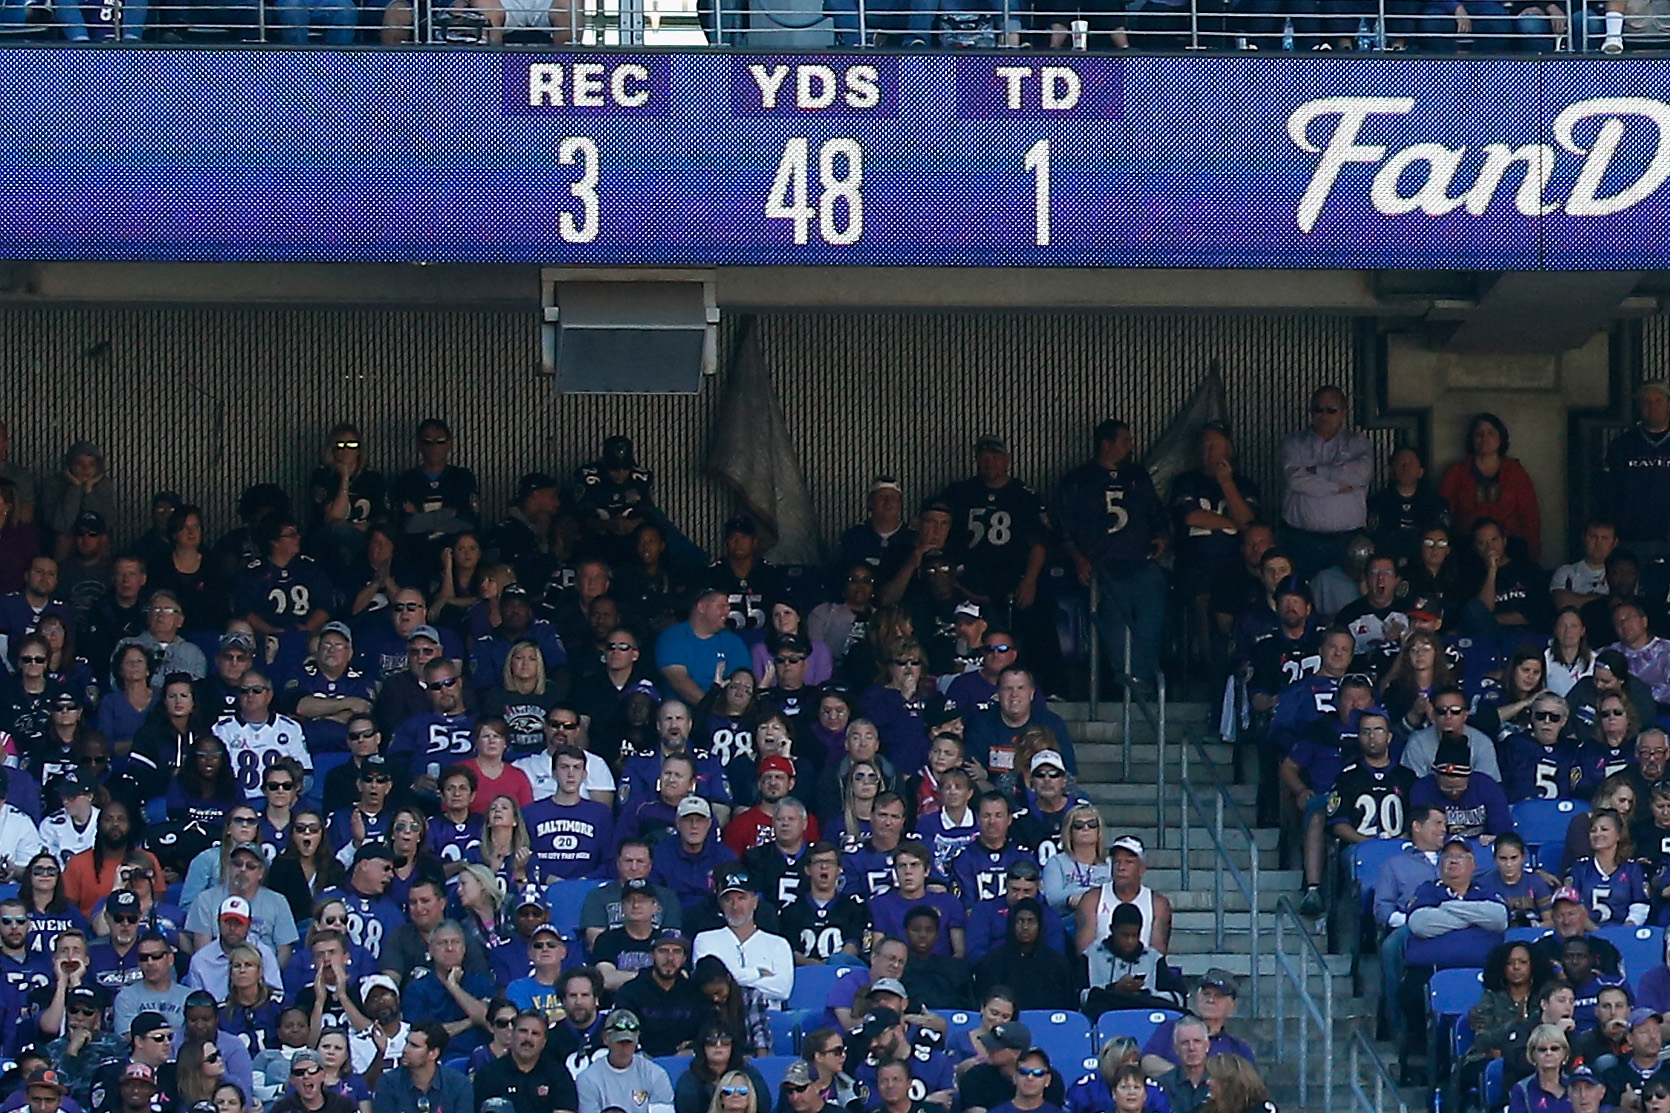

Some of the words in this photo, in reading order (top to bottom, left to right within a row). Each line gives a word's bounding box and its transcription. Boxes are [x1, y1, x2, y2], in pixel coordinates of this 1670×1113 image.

[528, 62, 651, 108] REC
[748, 64, 881, 110] YDS
[996, 66, 1082, 111] TD
[558, 136, 600, 244] 3
[765, 137, 864, 246] 48
[1024, 139, 1050, 246] 1
[967, 509, 1011, 545] 58
[1106, 491, 1128, 534] 5
[727, 593, 765, 630] 55
[427, 724, 471, 753] 55
[712, 729, 753, 767] 88
[1536, 764, 1558, 799] 5
[536, 821, 595, 837] BALTIMORE
[1357, 795, 1404, 836] 20
[557, 838, 575, 847] 20
[779, 878, 800, 910] 5
[1593, 889, 1612, 920] 5
[28, 919, 74, 931] AVENS
[347, 913, 381, 958] 88
